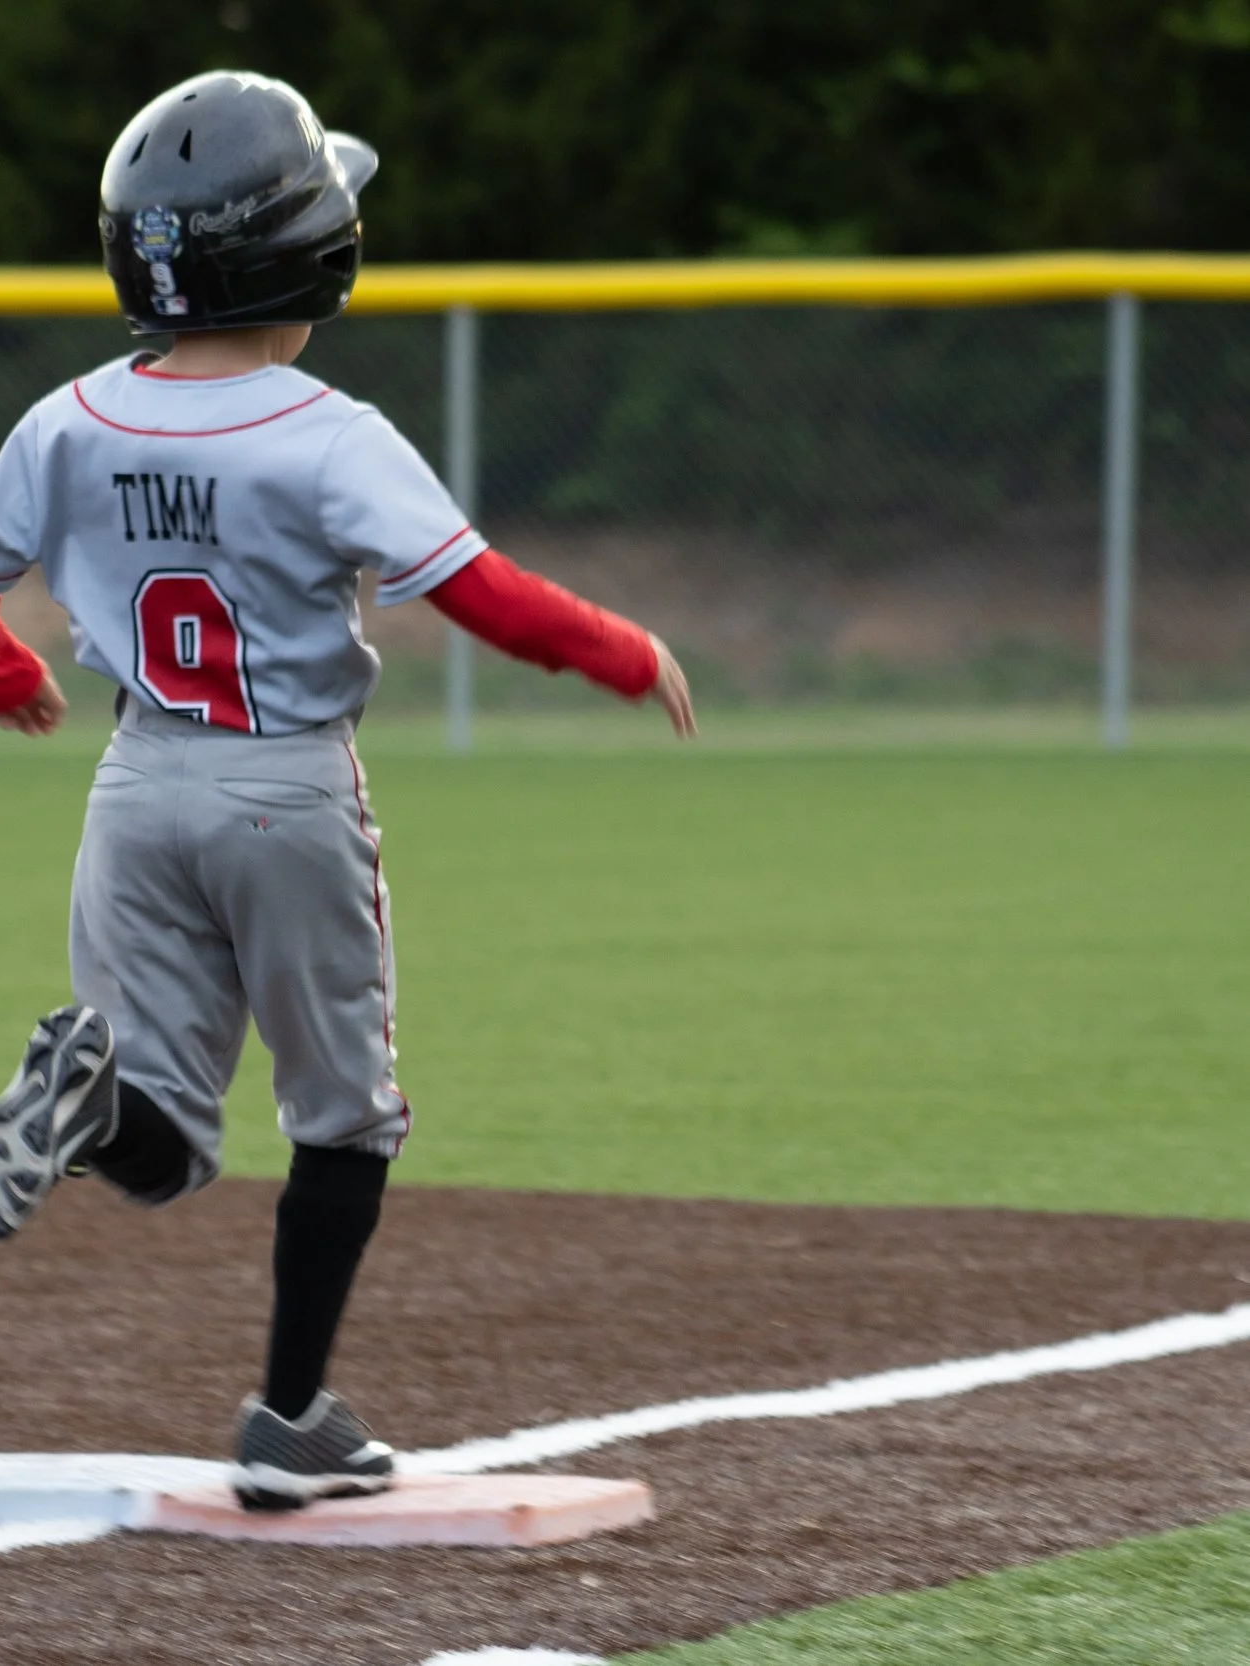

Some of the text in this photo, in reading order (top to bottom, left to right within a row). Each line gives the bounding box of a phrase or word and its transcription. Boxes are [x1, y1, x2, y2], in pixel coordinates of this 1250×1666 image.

[150, 262, 176, 295] 9
[112, 473, 218, 545] TIMM
[131, 568, 263, 735] 9
